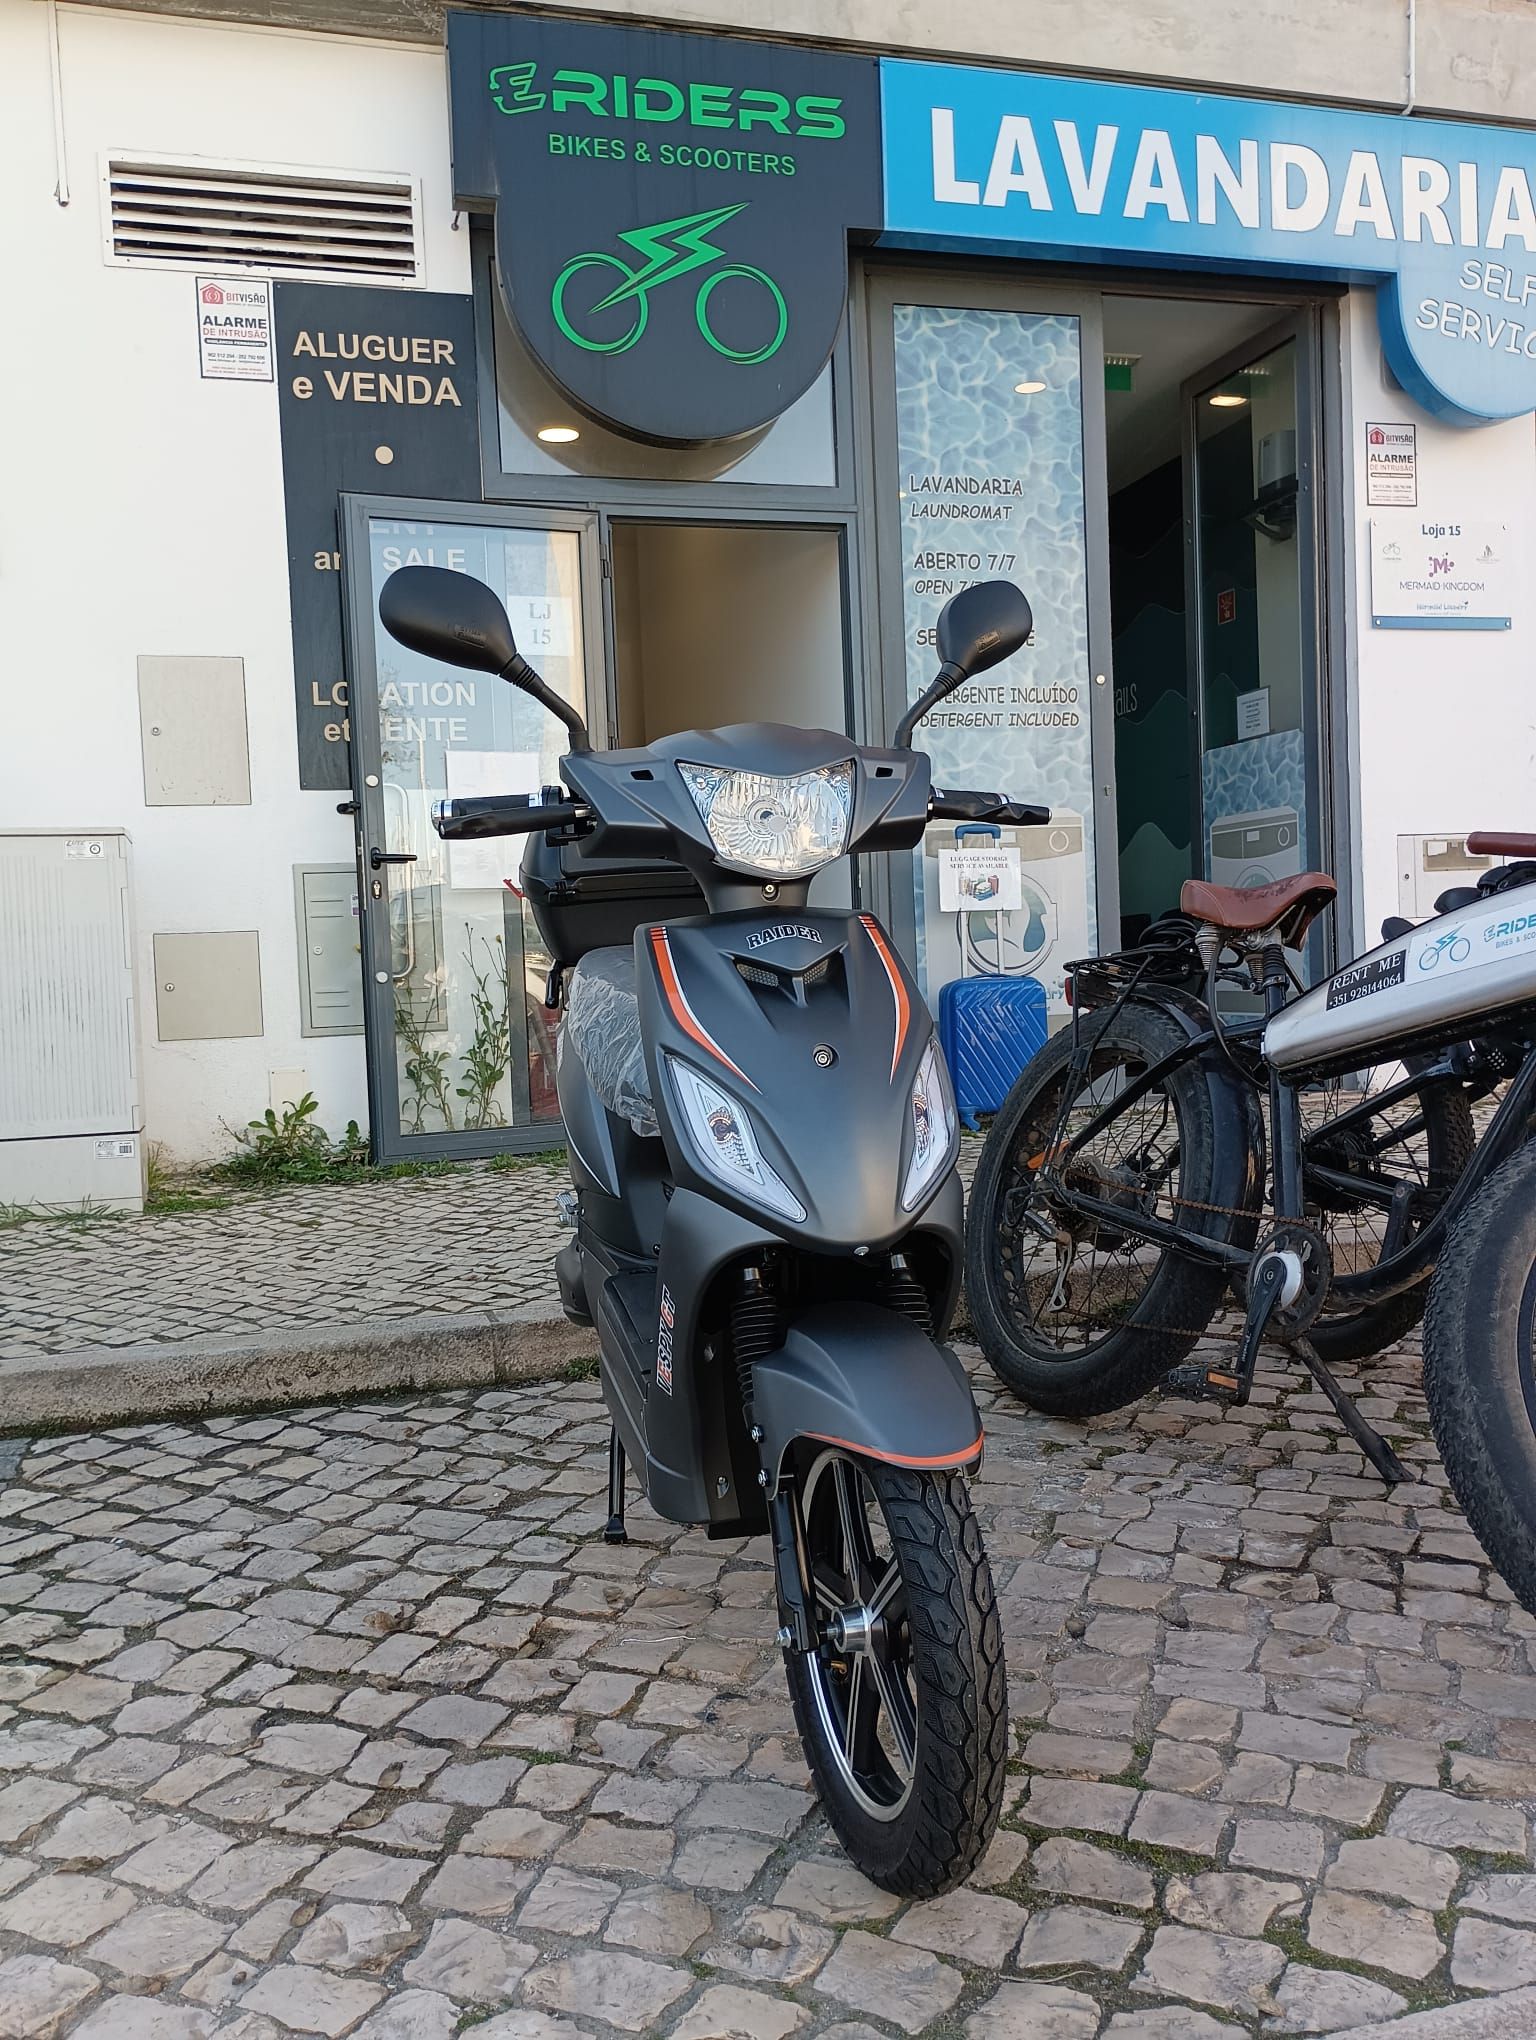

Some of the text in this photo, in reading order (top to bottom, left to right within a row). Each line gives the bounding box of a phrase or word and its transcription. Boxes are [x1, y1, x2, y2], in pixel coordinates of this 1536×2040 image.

[548, 133, 796, 177] BIKES & SCOOTERS
[930, 107, 1536, 253] LAVANDARIA
[1459, 259, 1536, 307] SELF
[226, 292, 266, 304] BITVISÃO
[203, 315, 267, 330] ALARME
[203, 327, 268, 339] DE INTRUSÃO
[292, 331, 456, 366] ALUGUER
[292, 370, 462, 407] e VENDA
[1385, 433, 1413, 443] BITVISÃO
[1370, 453, 1414, 464] ALARME
[1379, 464, 1414, 472] INTRUSÃO
[910, 475, 1024, 496] LAVANDARIA
[911, 502, 1013, 520] LAUNDROMAT
[1422, 523, 1461, 539] Loja 15
[383, 546, 466, 573] SALE
[913, 552, 1017, 572] ABERTO 7/7
[914, 580, 954, 595] OPEN
[1399, 581, 1485, 592] MERMAID KINGDOM
[529, 602, 552, 620] LJ
[531, 629, 552, 645] 15
[1010, 682, 1078, 704] INCLUÍDO
[920, 712, 1079, 728] DETERGENT INCLUDED
[746, 924, 823, 950] RAIDER
[1331, 953, 1401, 992] RENT ME
[1350, 973, 1401, 1001] 928144064
